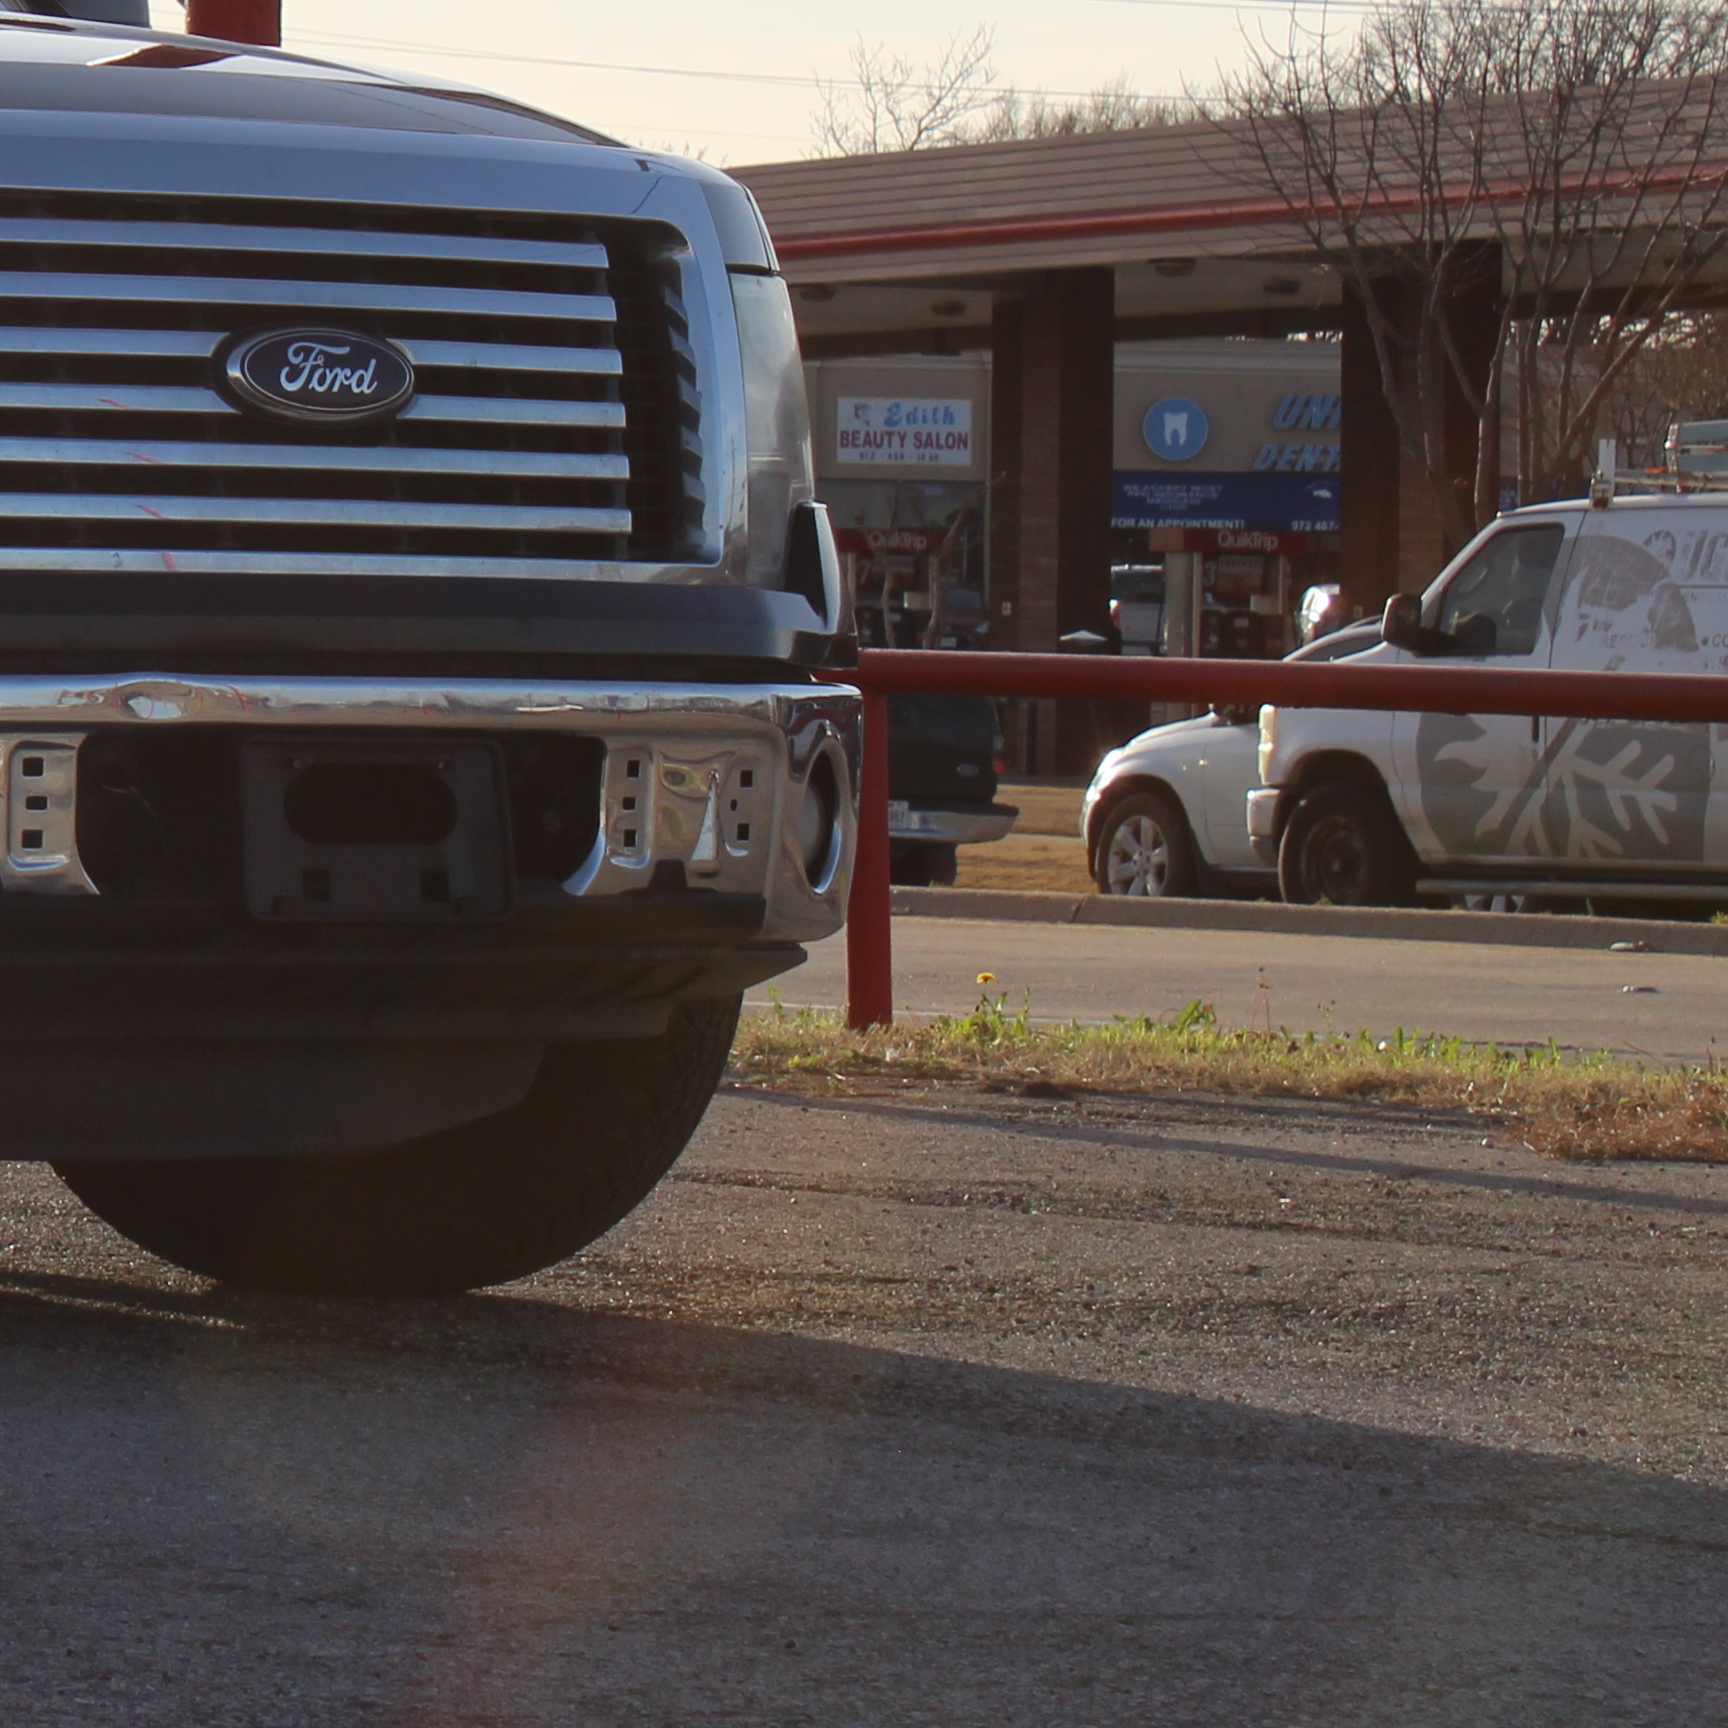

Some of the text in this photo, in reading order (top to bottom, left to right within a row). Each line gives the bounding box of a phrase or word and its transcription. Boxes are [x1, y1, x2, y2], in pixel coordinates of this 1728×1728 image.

[280, 342, 378, 394] Ford
[840, 430, 968, 450] BEAUTY SALON
[1253, 444, 1341, 471] DENT
[1111, 518, 1245, 529] FOR AN APPOINTMENT!
[1218, 531, 1278, 550] QuikTrip
